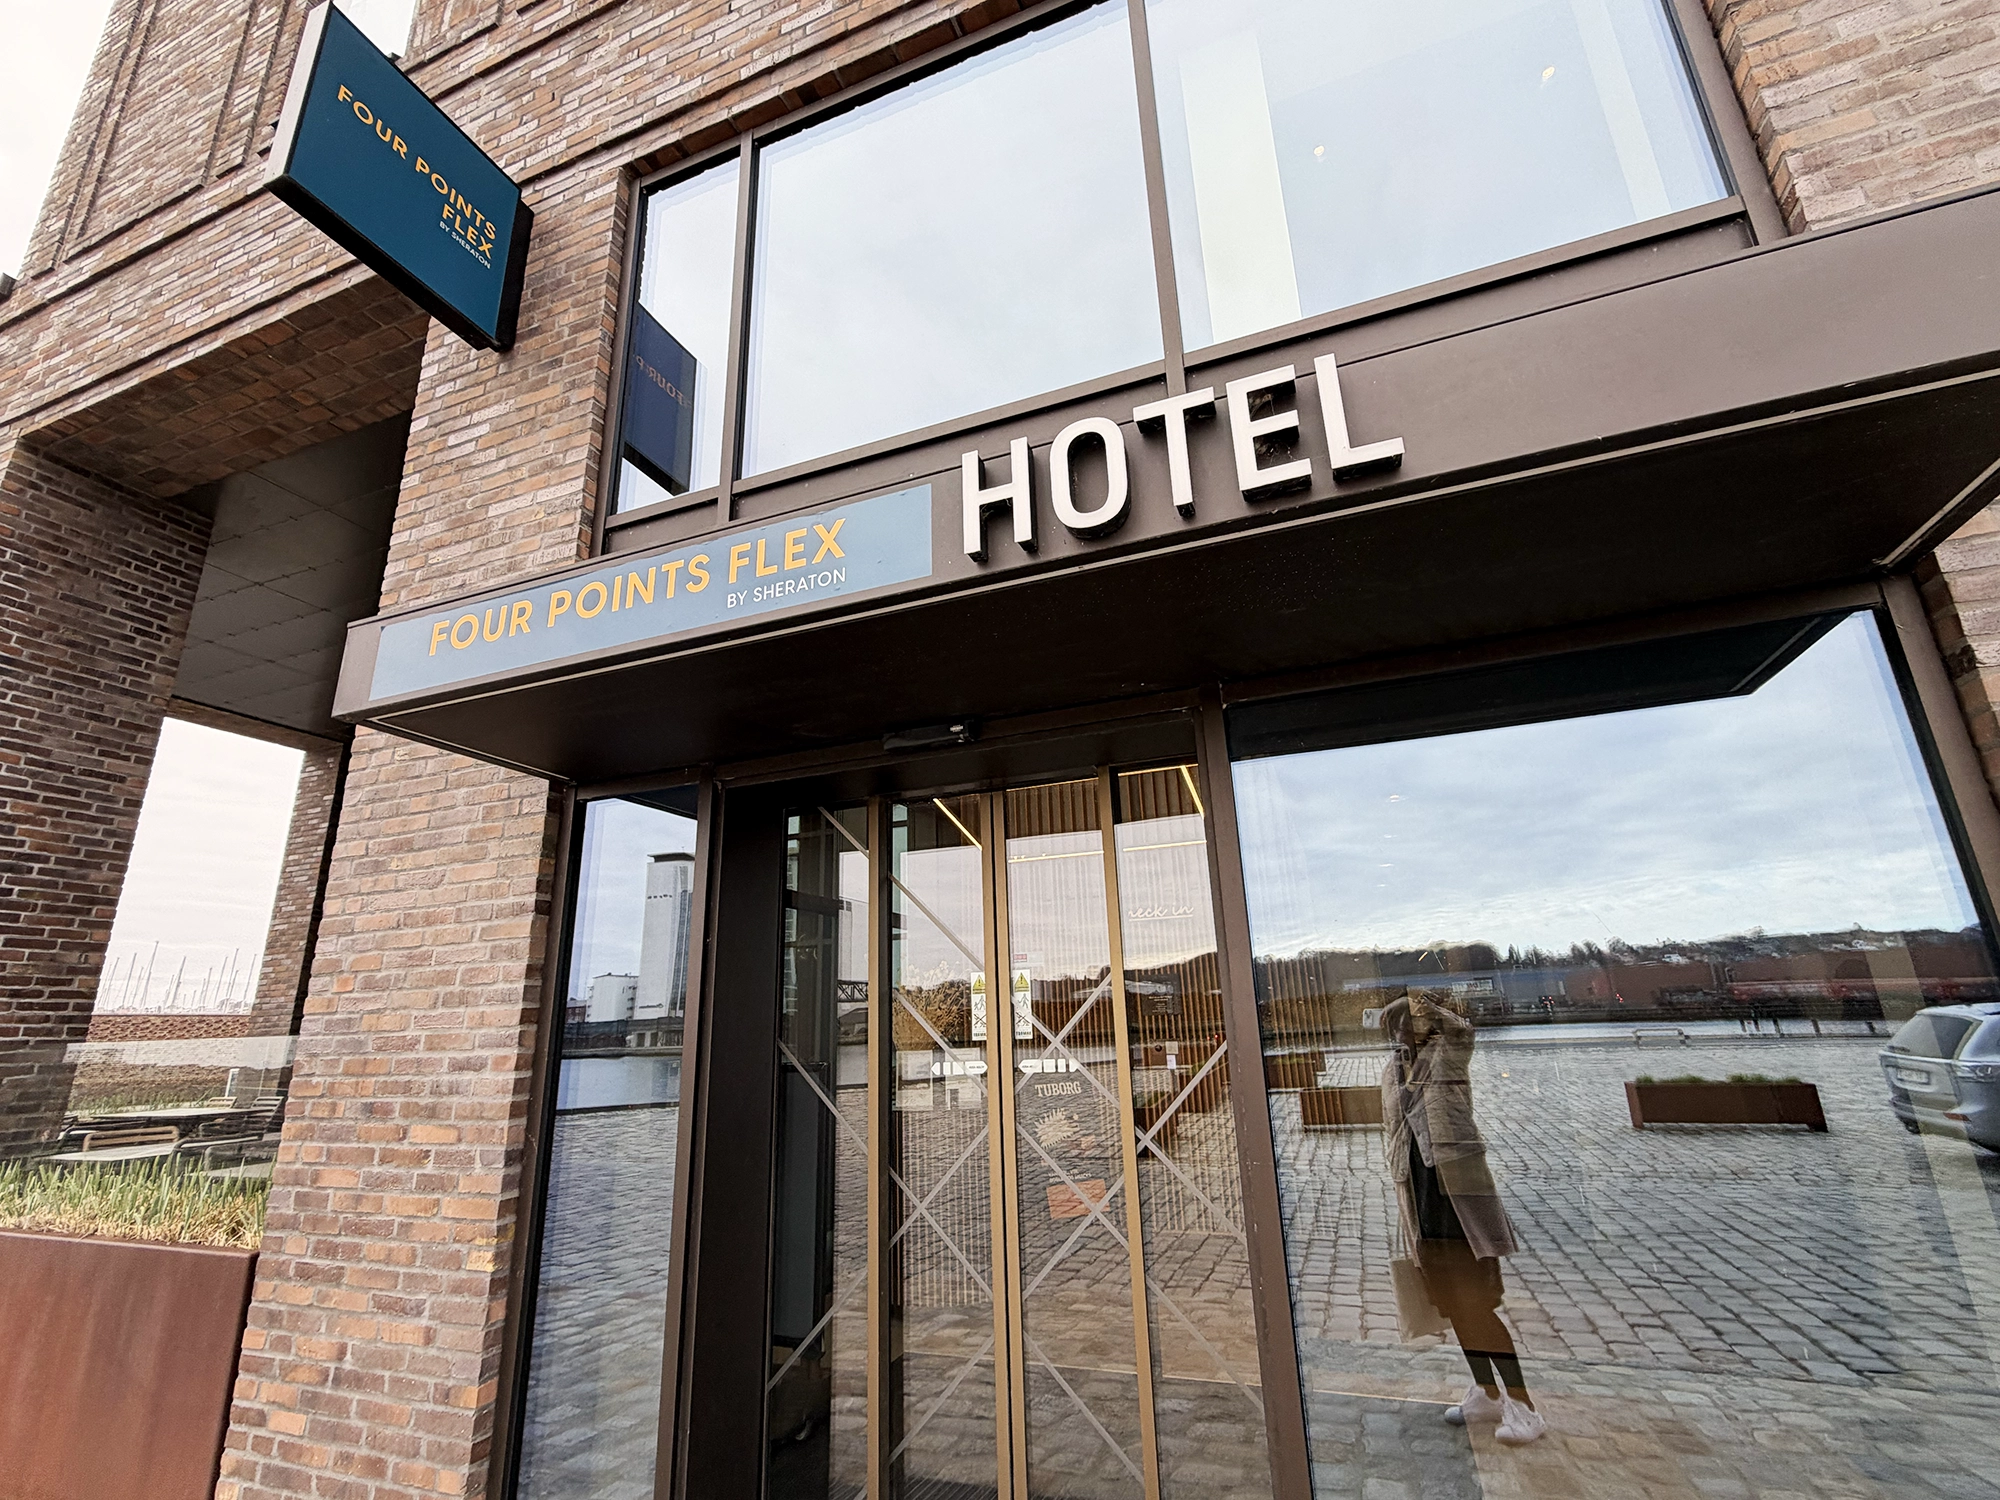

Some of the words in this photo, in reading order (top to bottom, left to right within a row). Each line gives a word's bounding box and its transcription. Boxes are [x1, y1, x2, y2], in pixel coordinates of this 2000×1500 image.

[337, 84, 408, 160] FOUR
[415, 156, 497, 240] POINTS
[439, 220, 450, 232] BY
[451, 231, 491, 269] SHERATON
[442, 203, 494, 259] FLEX
[961, 353, 1405, 556] HOTEL
[428, 600, 532, 657] FOUR
[546, 554, 710, 628] POINTS
[727, 518, 847, 584] FLEX
[726, 589, 747, 609] BY
[752, 567, 847, 604] SHERATON
[1172, 902, 1194, 916] in
[1035, 1081, 1082, 1097] TUBORG
